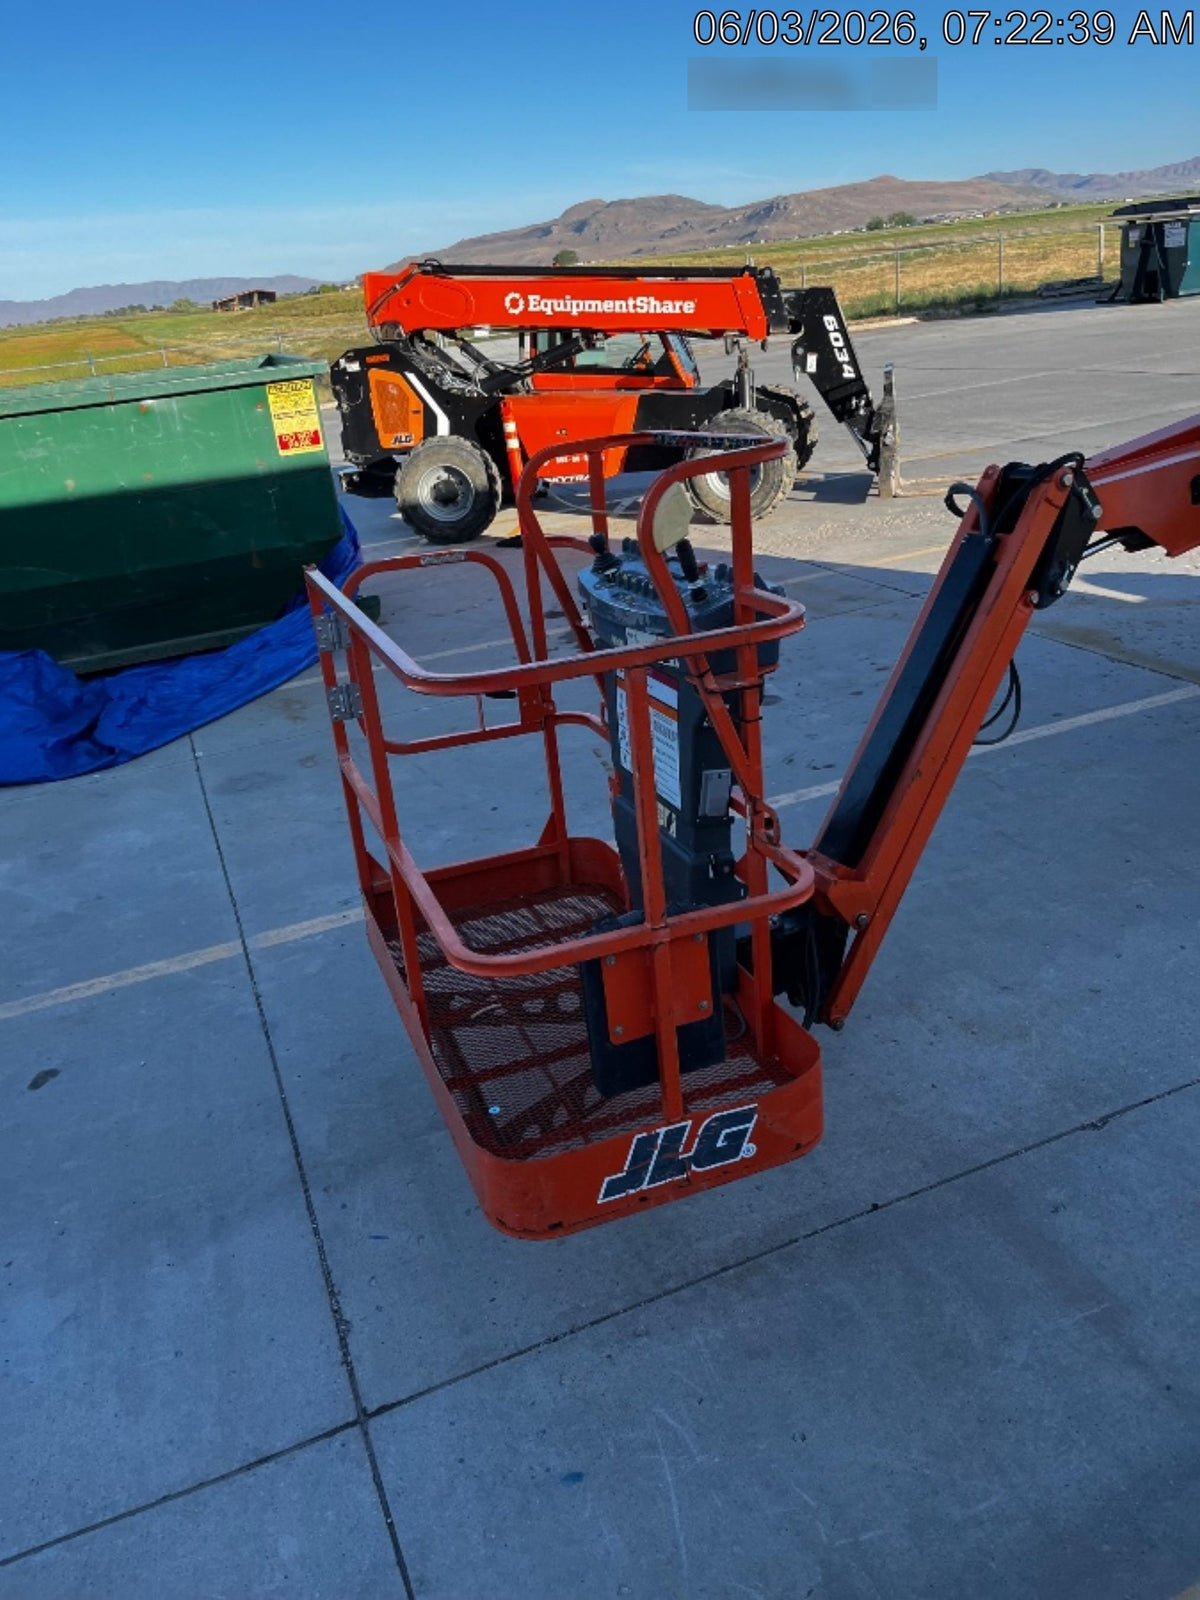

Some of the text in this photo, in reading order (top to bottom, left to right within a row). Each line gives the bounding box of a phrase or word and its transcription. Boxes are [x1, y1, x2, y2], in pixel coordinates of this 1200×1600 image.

[527, 294, 696, 316] EquipmentShare
[823, 314, 856, 378] 6034
[391, 433, 415, 445] JLG
[597, 1103, 758, 1204] JLG
